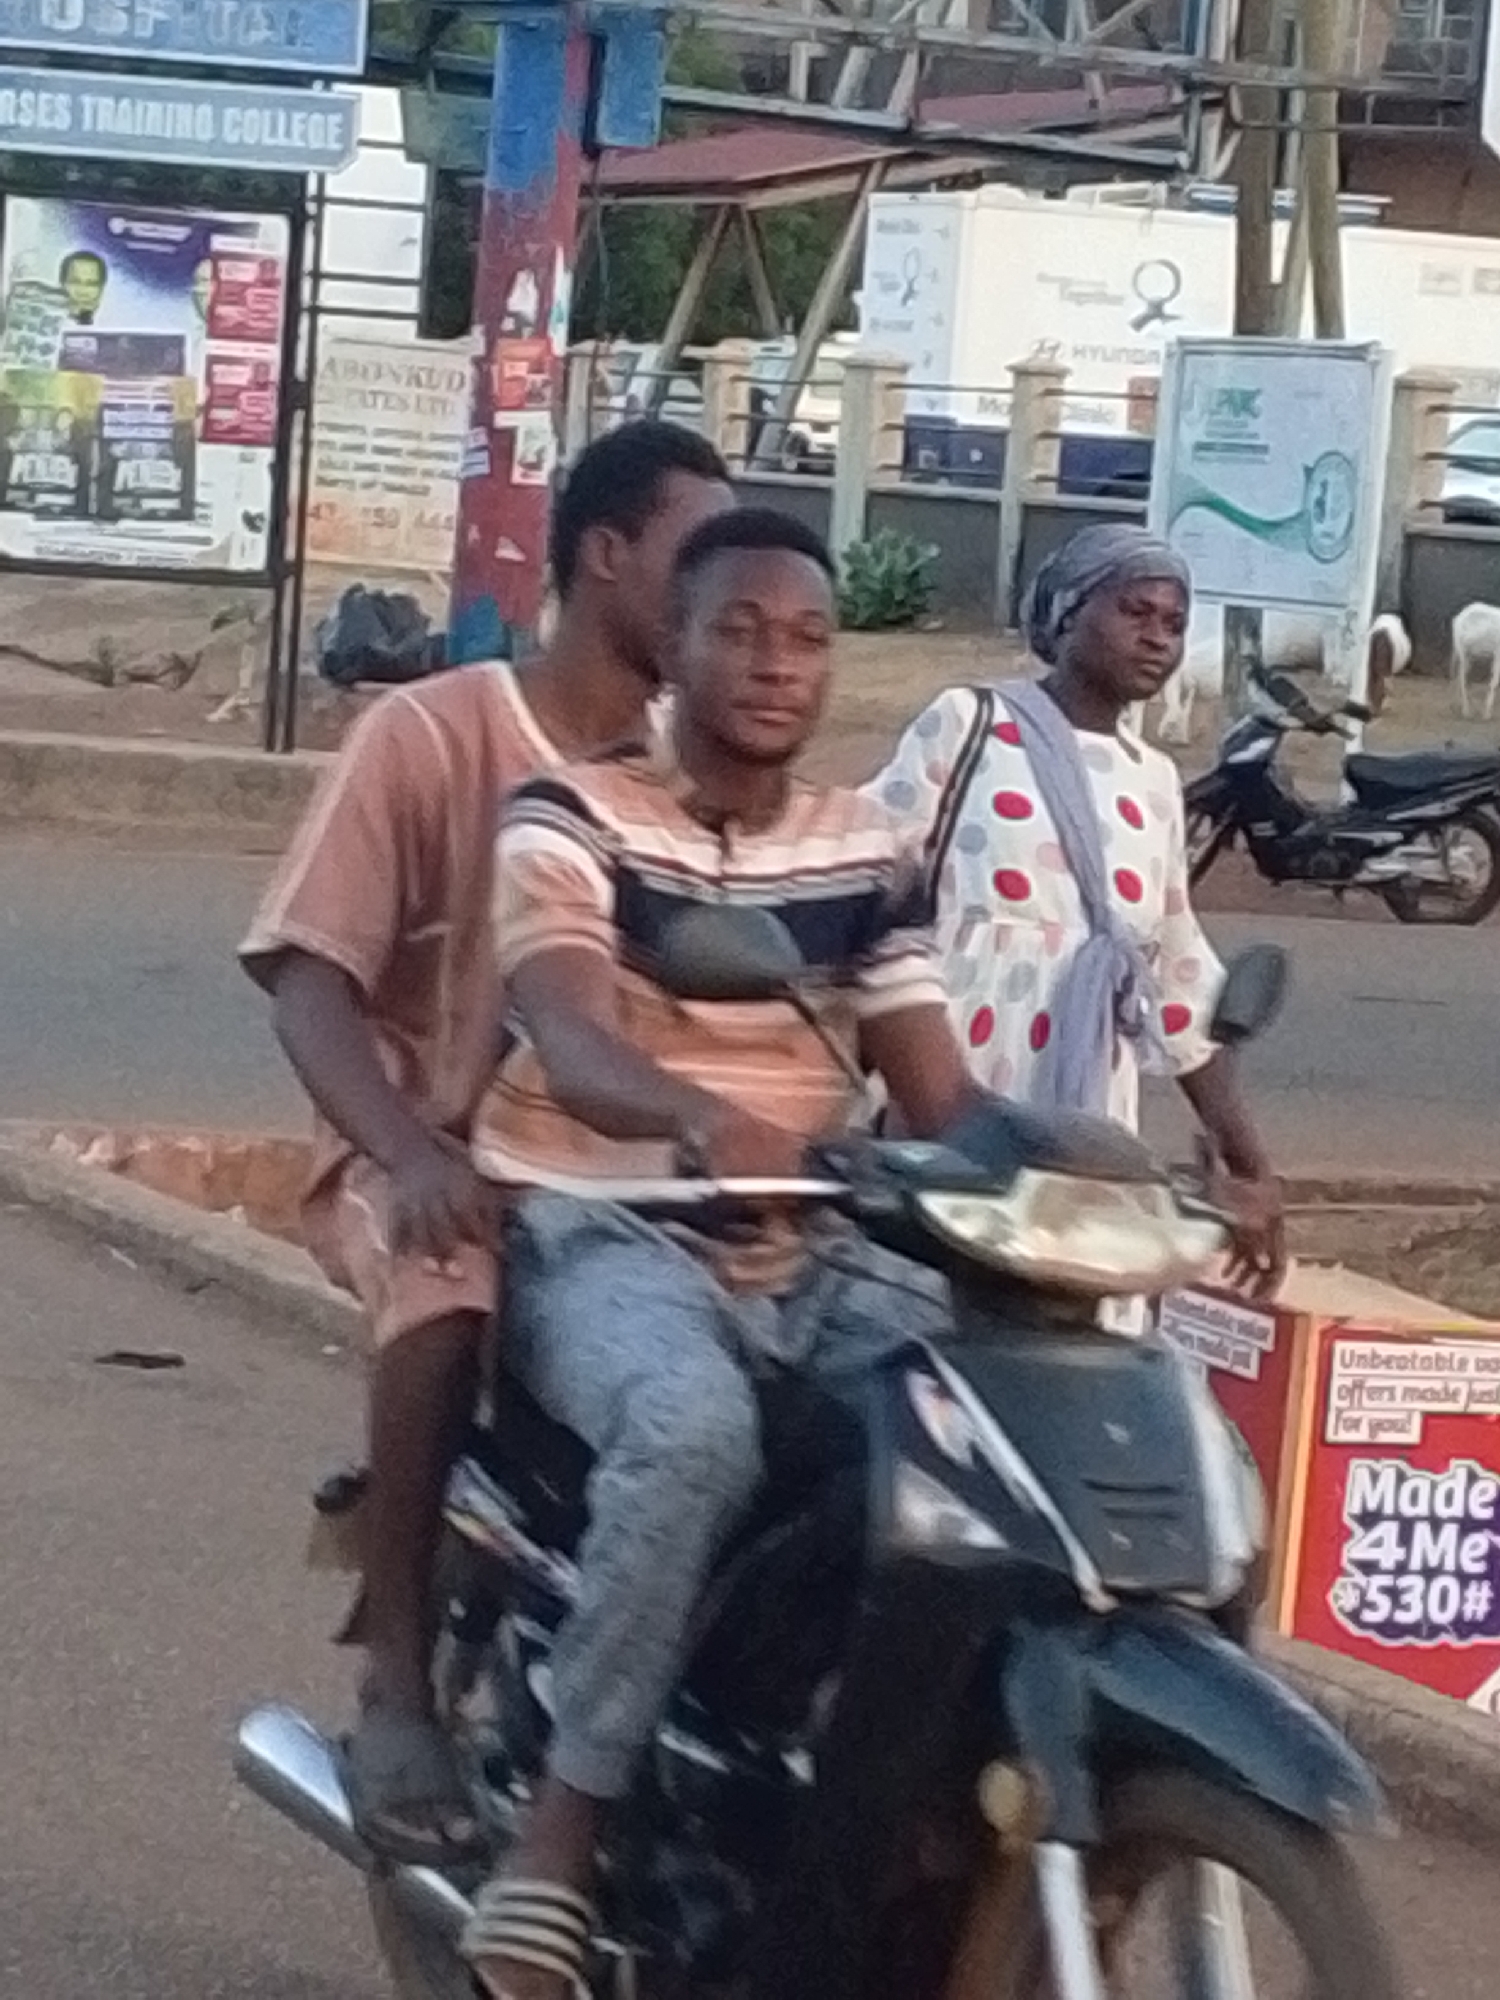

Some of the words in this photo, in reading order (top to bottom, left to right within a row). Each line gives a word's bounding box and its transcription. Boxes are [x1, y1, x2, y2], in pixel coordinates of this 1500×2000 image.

[80, 94, 214, 142] TRAINING
[222, 106, 344, 150] COLLEGE
[1340, 1348, 1469, 1373] Unbeatable
[1337, 1379, 1396, 1409] offers
[1401, 1381, 1462, 1403] made
[1333, 1406, 1362, 1436] for
[1350, 1466, 1497, 1519] Made
